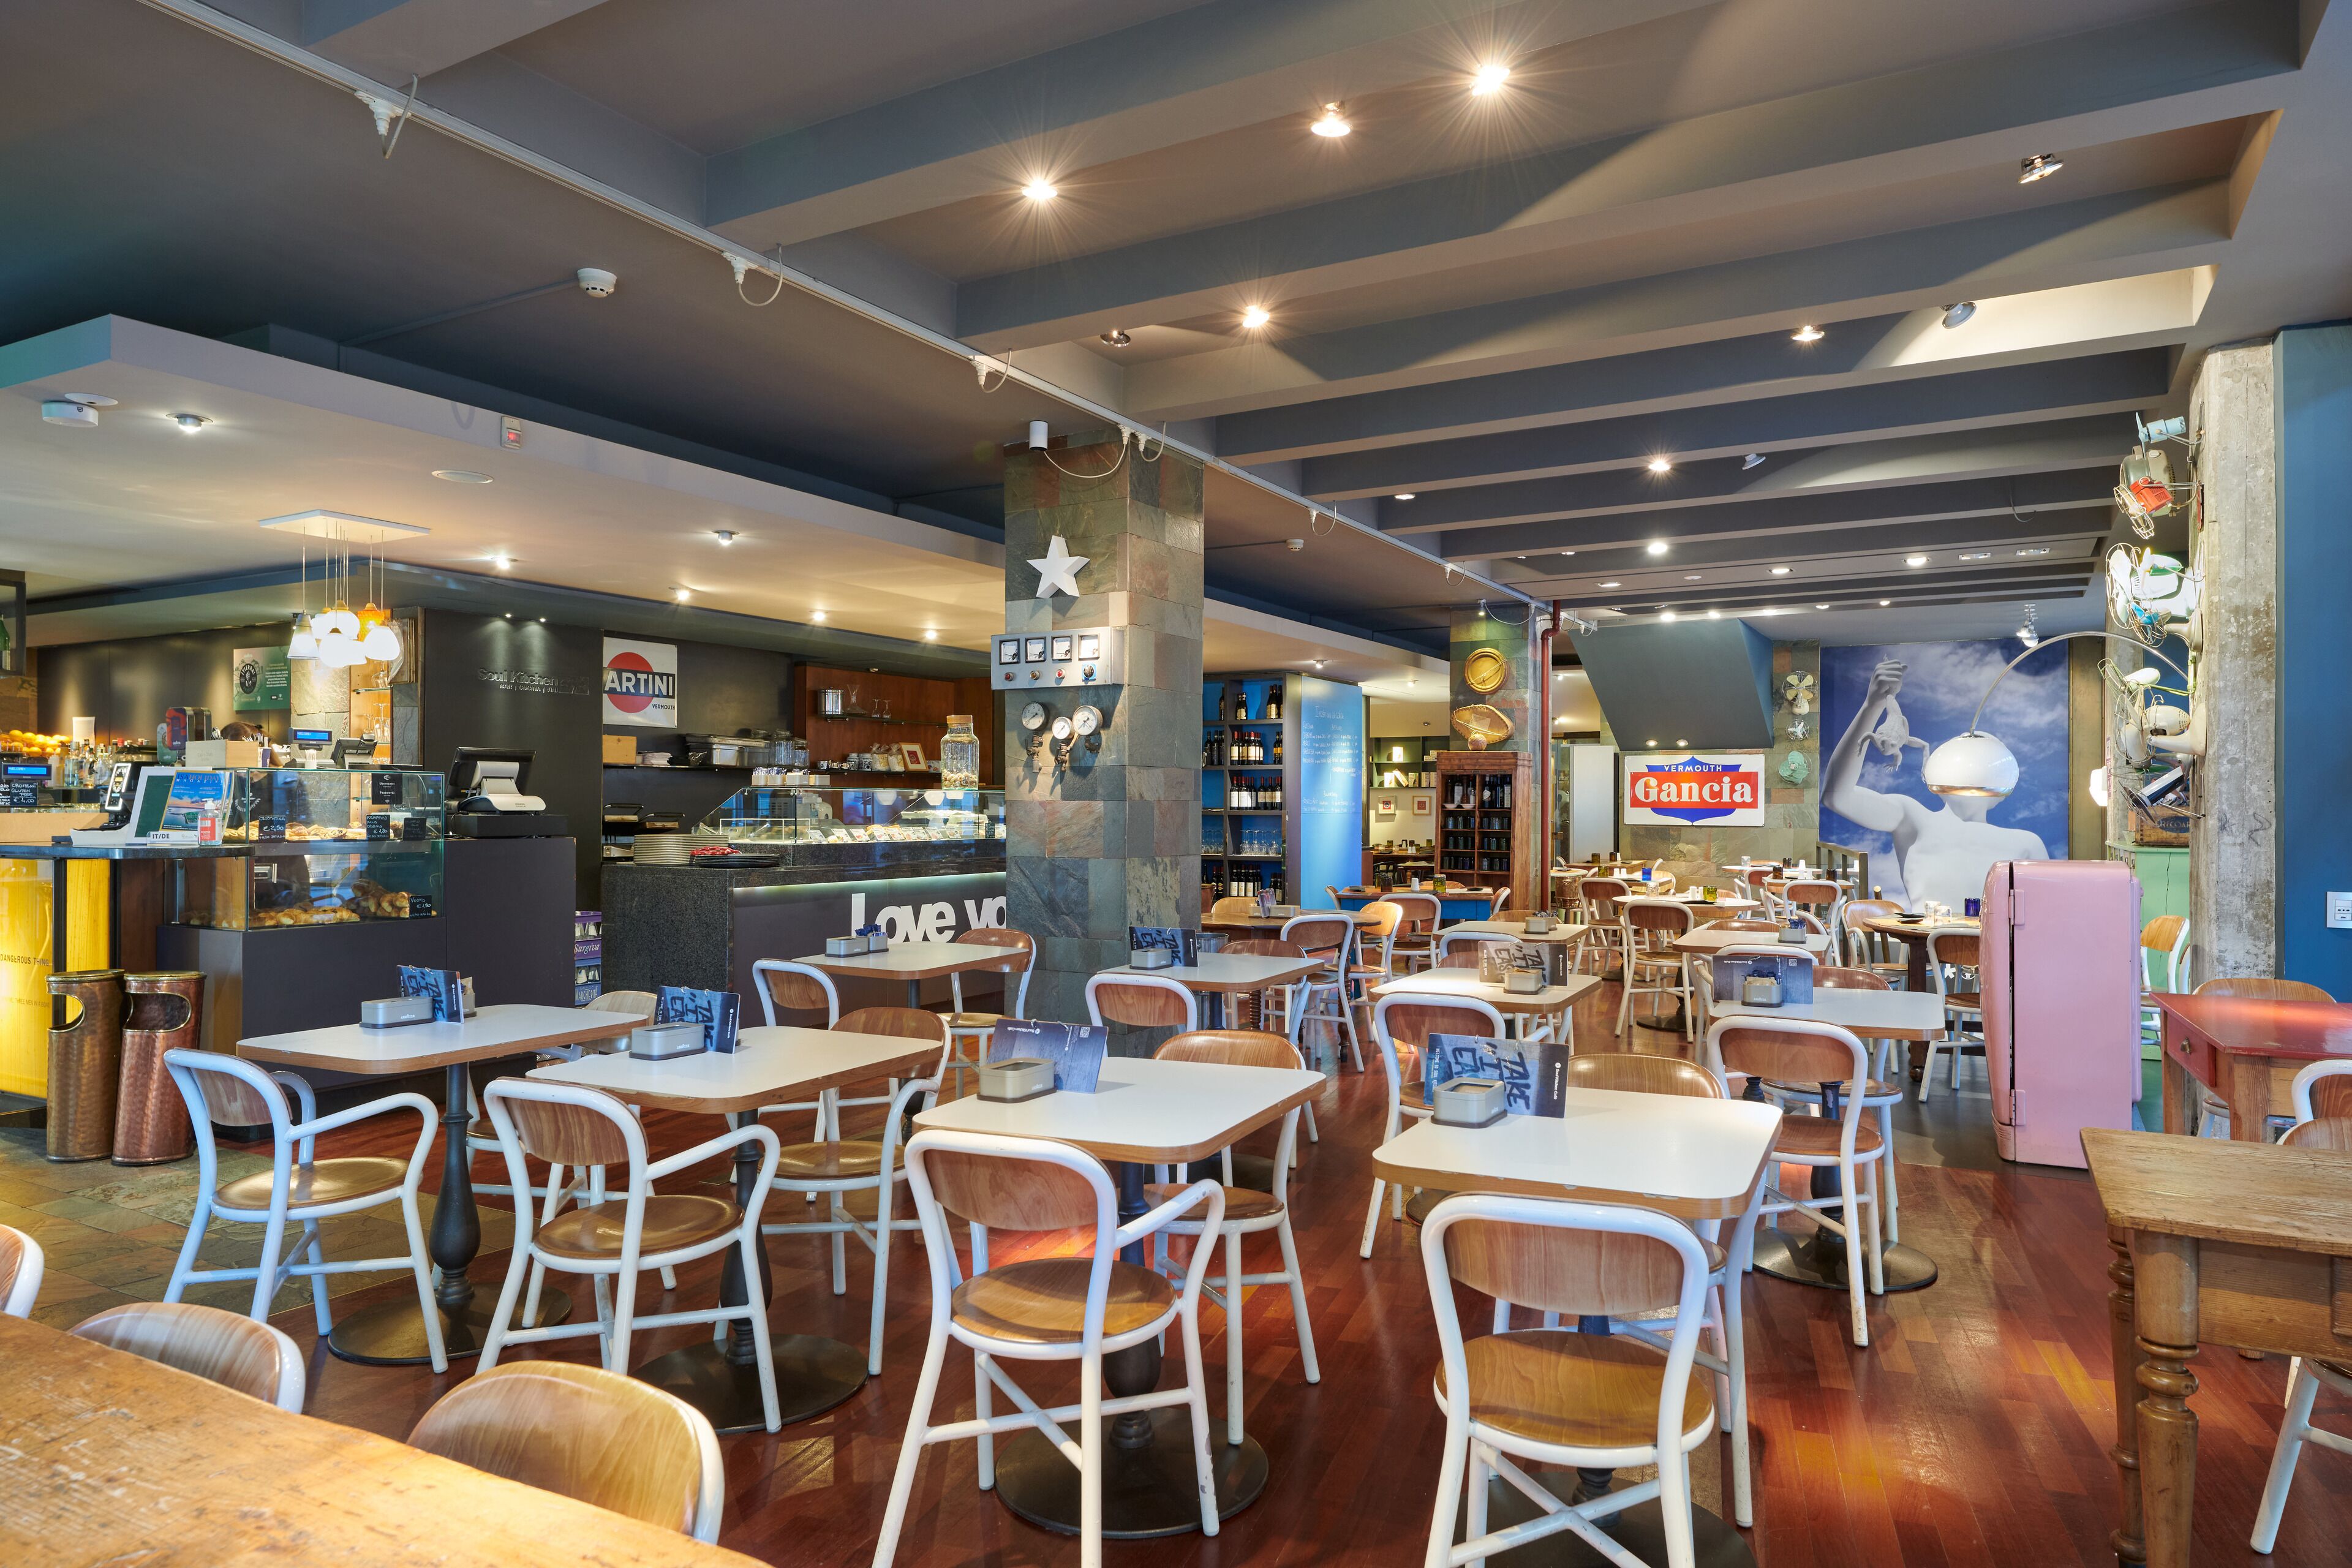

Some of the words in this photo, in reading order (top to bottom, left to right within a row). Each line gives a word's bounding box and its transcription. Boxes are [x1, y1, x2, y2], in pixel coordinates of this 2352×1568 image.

[479, 669, 507, 682] Soul
[510, 671, 558, 686] Kitchen
[604, 671, 673, 696] ARTINI
[1635, 776, 1753, 803] Gancia
[851, 893, 956, 943] Love
[575, 943, 600, 954] Surgiva
[33, 957, 49, 967] THING
[1501, 1052, 1531, 1110] TAKE
